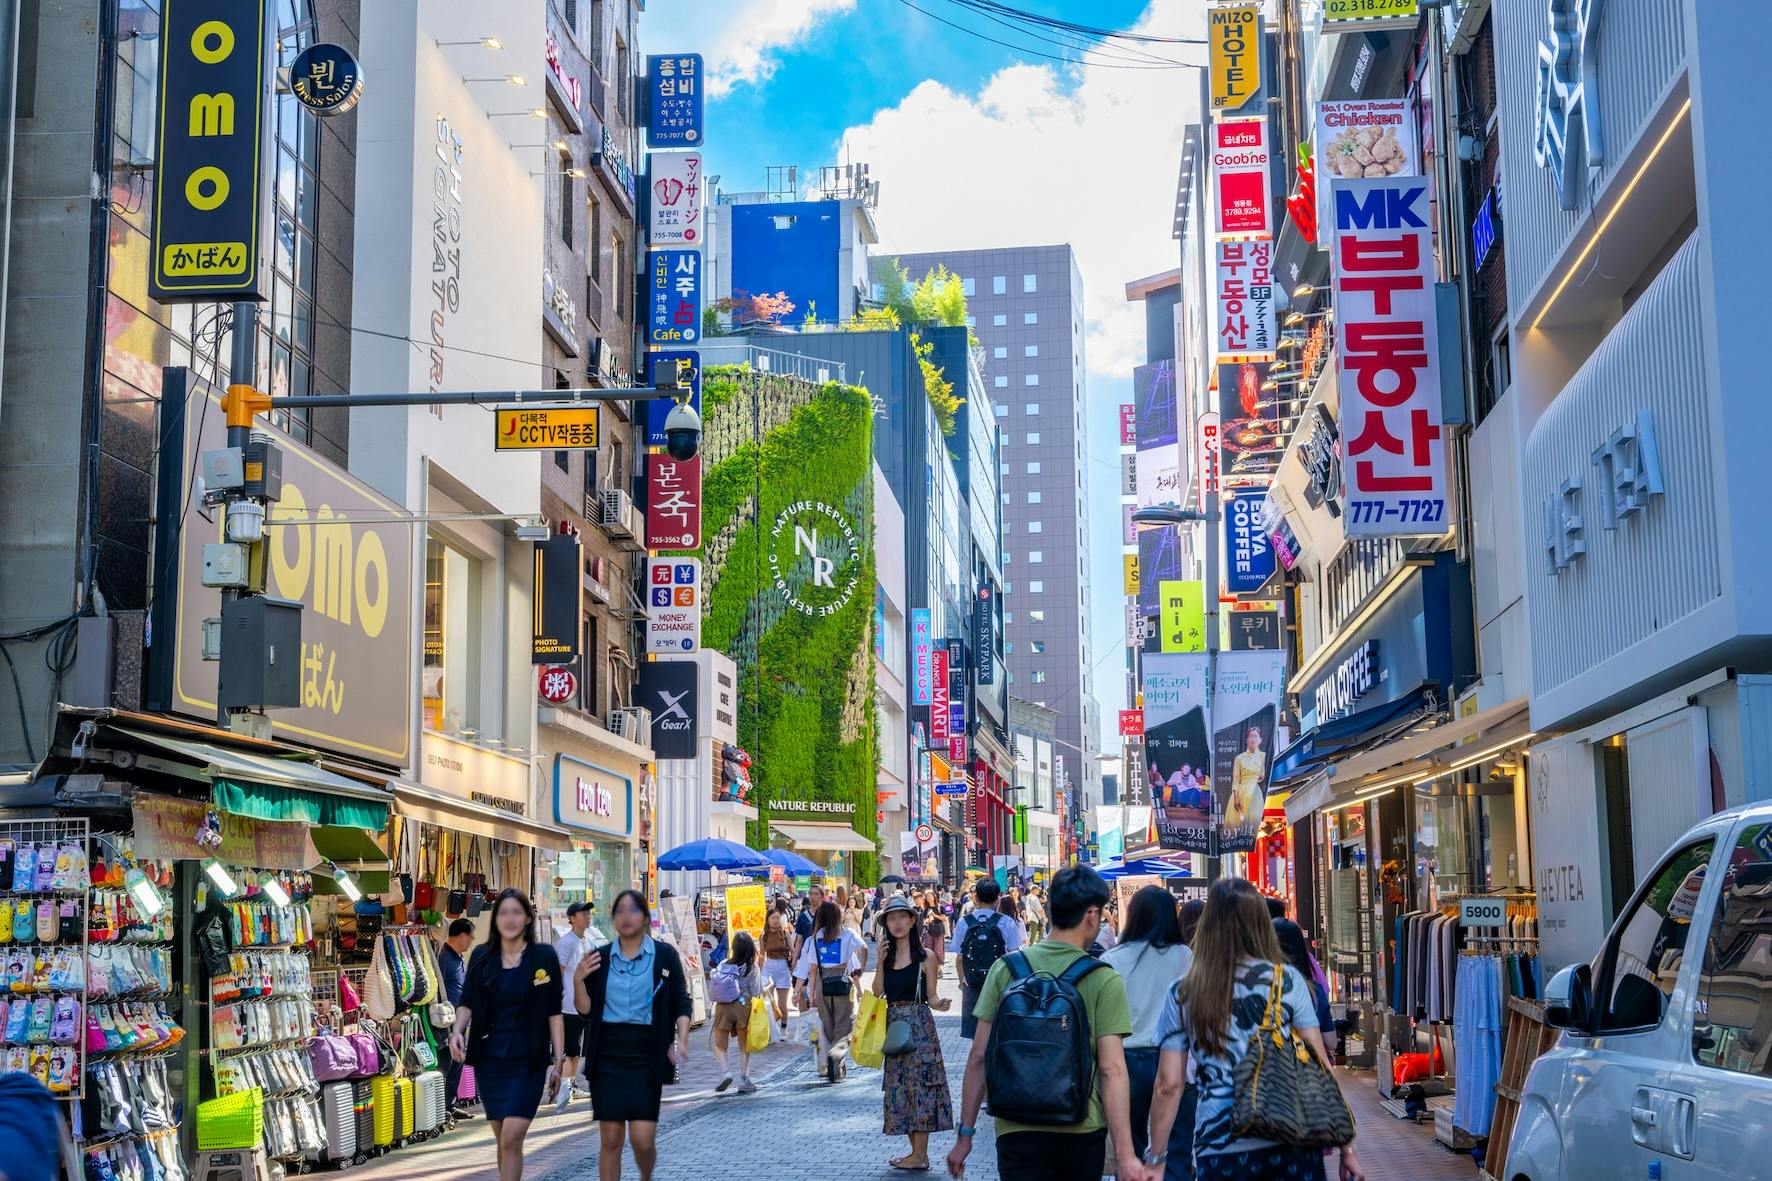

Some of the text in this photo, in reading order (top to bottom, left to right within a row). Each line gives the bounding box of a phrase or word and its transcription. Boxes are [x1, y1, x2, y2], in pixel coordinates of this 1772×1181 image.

[1213, 12, 1253, 24] MIZO
[660, 58, 696, 77] 종합
[1223, 25, 1245, 96] HOTEL
[294, 74, 353, 106] Dress Salon
[1214, 97, 1228, 106] 8F
[1322, 102, 1405, 112] No.1 Oven Roasted
[1325, 111, 1403, 127] Chicken
[1214, 151, 1268, 166] Goobne
[685, 158, 698, 224] マッサージ
[447, 128, 463, 314] PHOTO
[1336, 188, 1428, 229] MK
[171, 245, 241, 270] かばん
[429, 117, 448, 421] SIGNATURE
[1249, 243, 1272, 286] 성모
[1220, 243, 1249, 349] 부동산
[1253, 288, 1268, 298] 3F
[653, 329, 681, 340] Cafe
[1340, 234, 1440, 492] 부동산
[520, 413, 547, 424] 다목적
[520, 423, 594, 444] CCTV작동중
[653, 463, 696, 527] 본죽
[1352, 500, 1444, 523] 777-7727
[771, 500, 860, 562] NATURE REPUBLIC
[1233, 499, 1251, 573] COFFEE
[1251, 501, 1267, 557] EDIYA
[768, 553, 858, 617] NATURE REPUBLIC
[1265, 585, 1282, 597] 1F
[651, 623, 694, 632] EXCHANGE
[659, 614, 687, 622] MONEY
[1169, 597, 1183, 644] mid
[1240, 616, 1270, 633] 루키
[915, 623, 929, 700] KIMECCA
[980, 627, 990, 680] SKYPARK
[299, 641, 344, 715] ばん
[544, 672, 568, 698] 粥
[1316, 640, 1372, 726] EDIYA COFFEE
[932, 652, 947, 737] ORANGE MART
[1147, 690, 1180, 703] 이야기
[661, 719, 692, 730] GearX
[976, 770, 985, 797] SPAO
[768, 800, 856, 813] NATURE REPUBLIC
[219, 814, 256, 838] OCKS
[919, 829, 930, 837] 30
[1540, 865, 1584, 902] HEYTEA
[1466, 906, 1500, 918] 5900
